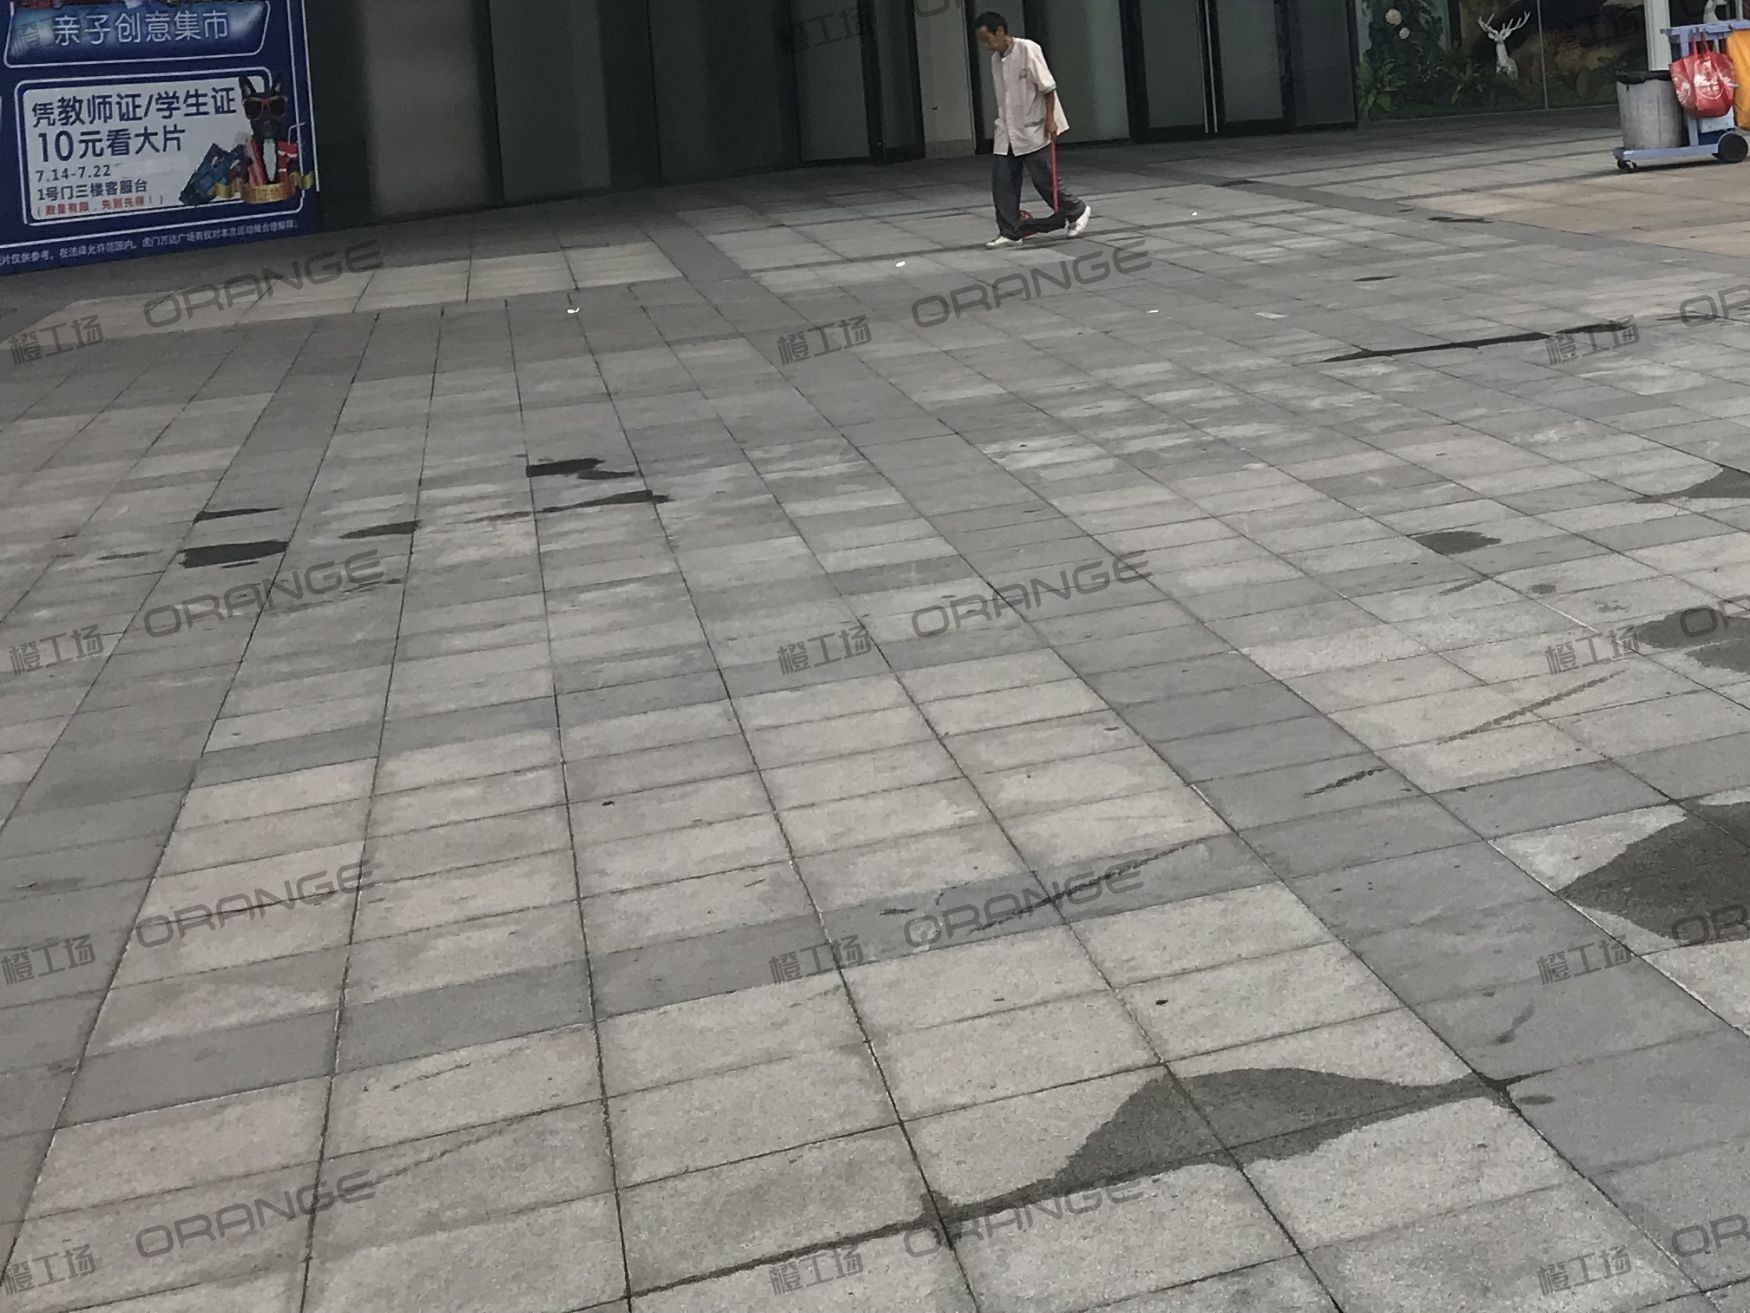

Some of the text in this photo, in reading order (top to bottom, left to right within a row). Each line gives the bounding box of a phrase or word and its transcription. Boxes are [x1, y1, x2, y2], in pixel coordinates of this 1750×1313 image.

[52, 9, 229, 46] 亲子创意集市
[31, 86, 237, 128] 凭教师证/学生证
[37, 124, 186, 163] 10元看大片
[35, 164, 111, 183] 7.14-7.22
[36, 179, 148, 201] 1号门三楼客服台
